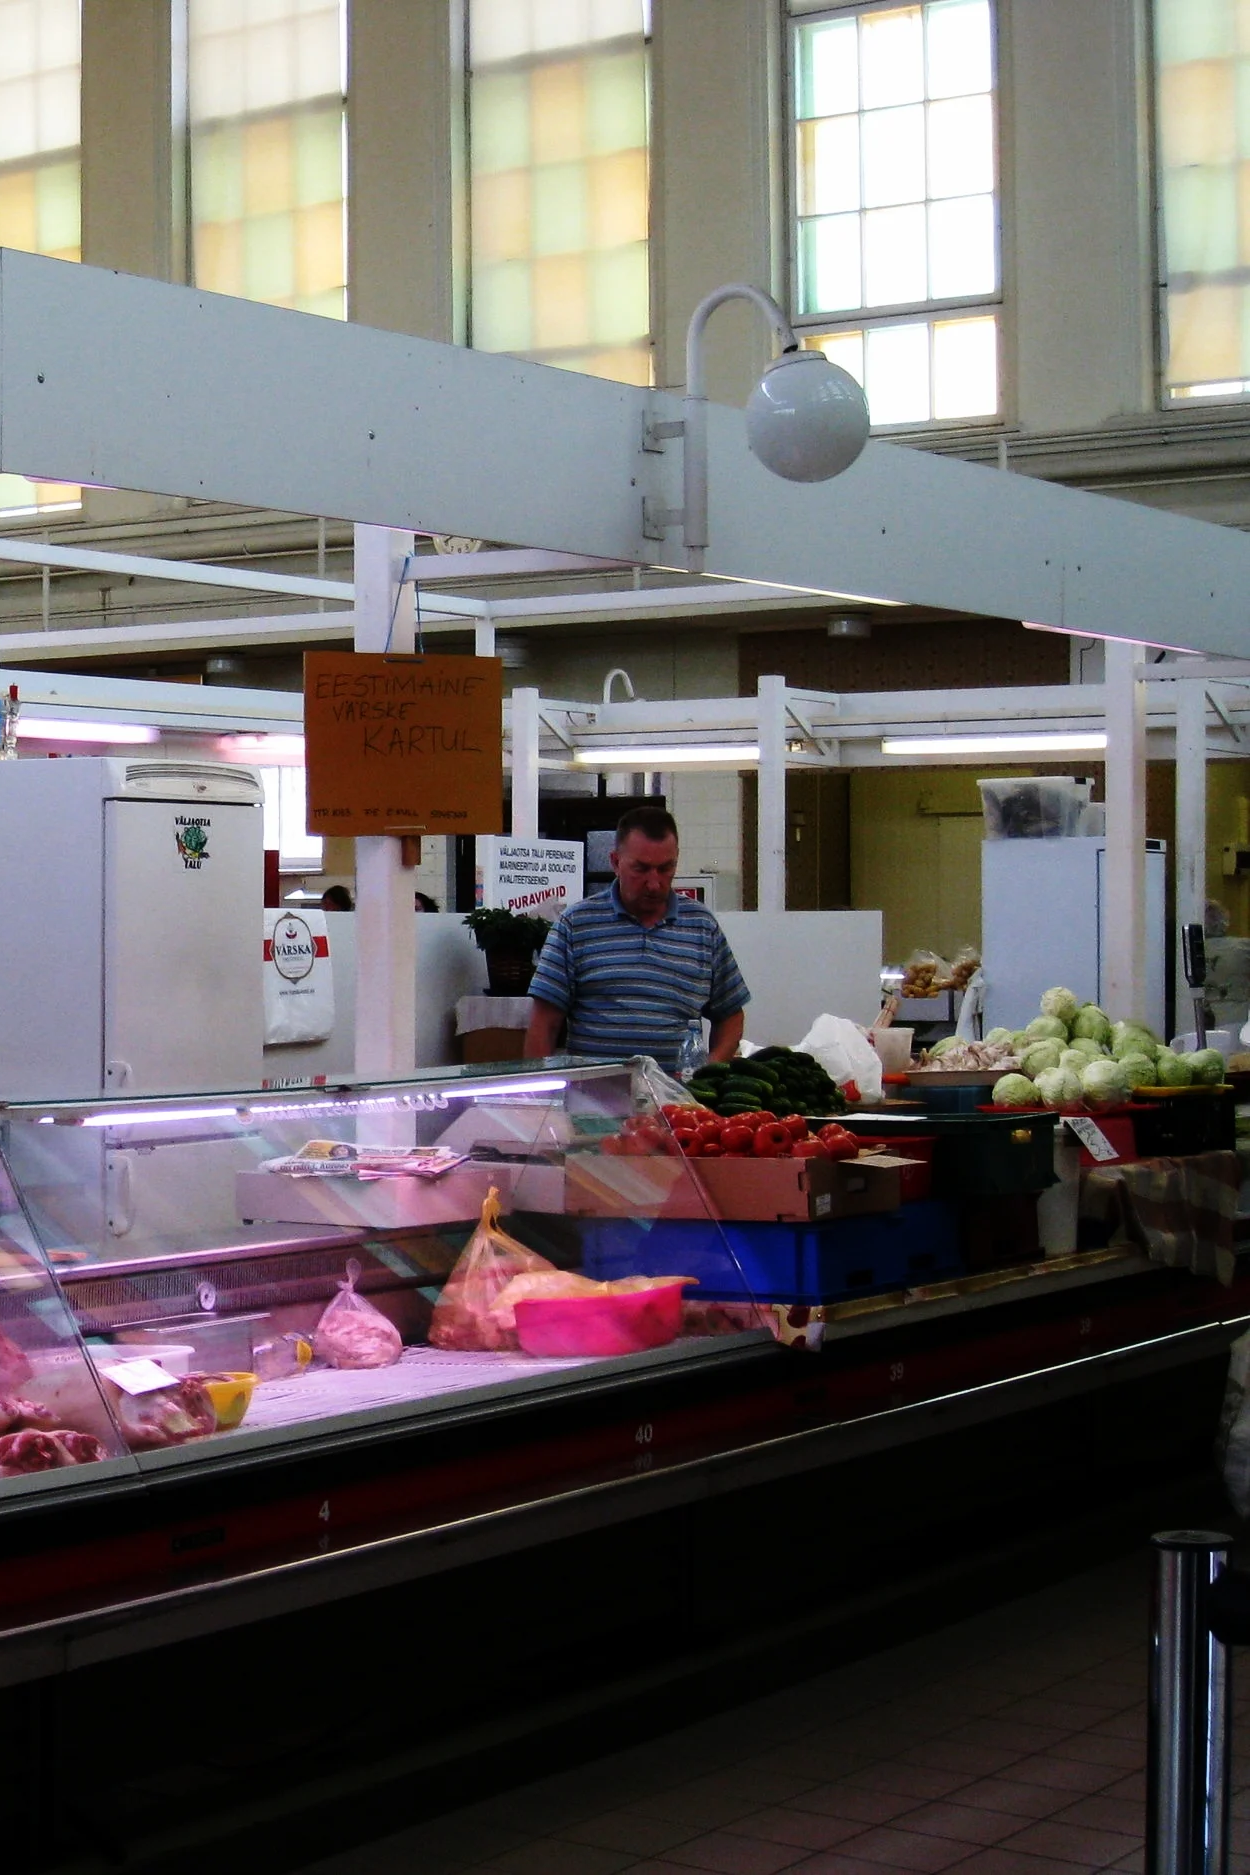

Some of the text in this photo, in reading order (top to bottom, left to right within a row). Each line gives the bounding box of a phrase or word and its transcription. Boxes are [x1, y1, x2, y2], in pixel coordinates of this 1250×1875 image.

[315, 671, 486, 699] EESTIMAINE
[332, 699, 417, 721] VÄRSKE
[363, 724, 483, 757] KARTUL
[508, 885, 567, 911] PURAVIKUD
[275, 943, 312, 957] VÄRSKA
[635, 1424, 654, 1445] 40
